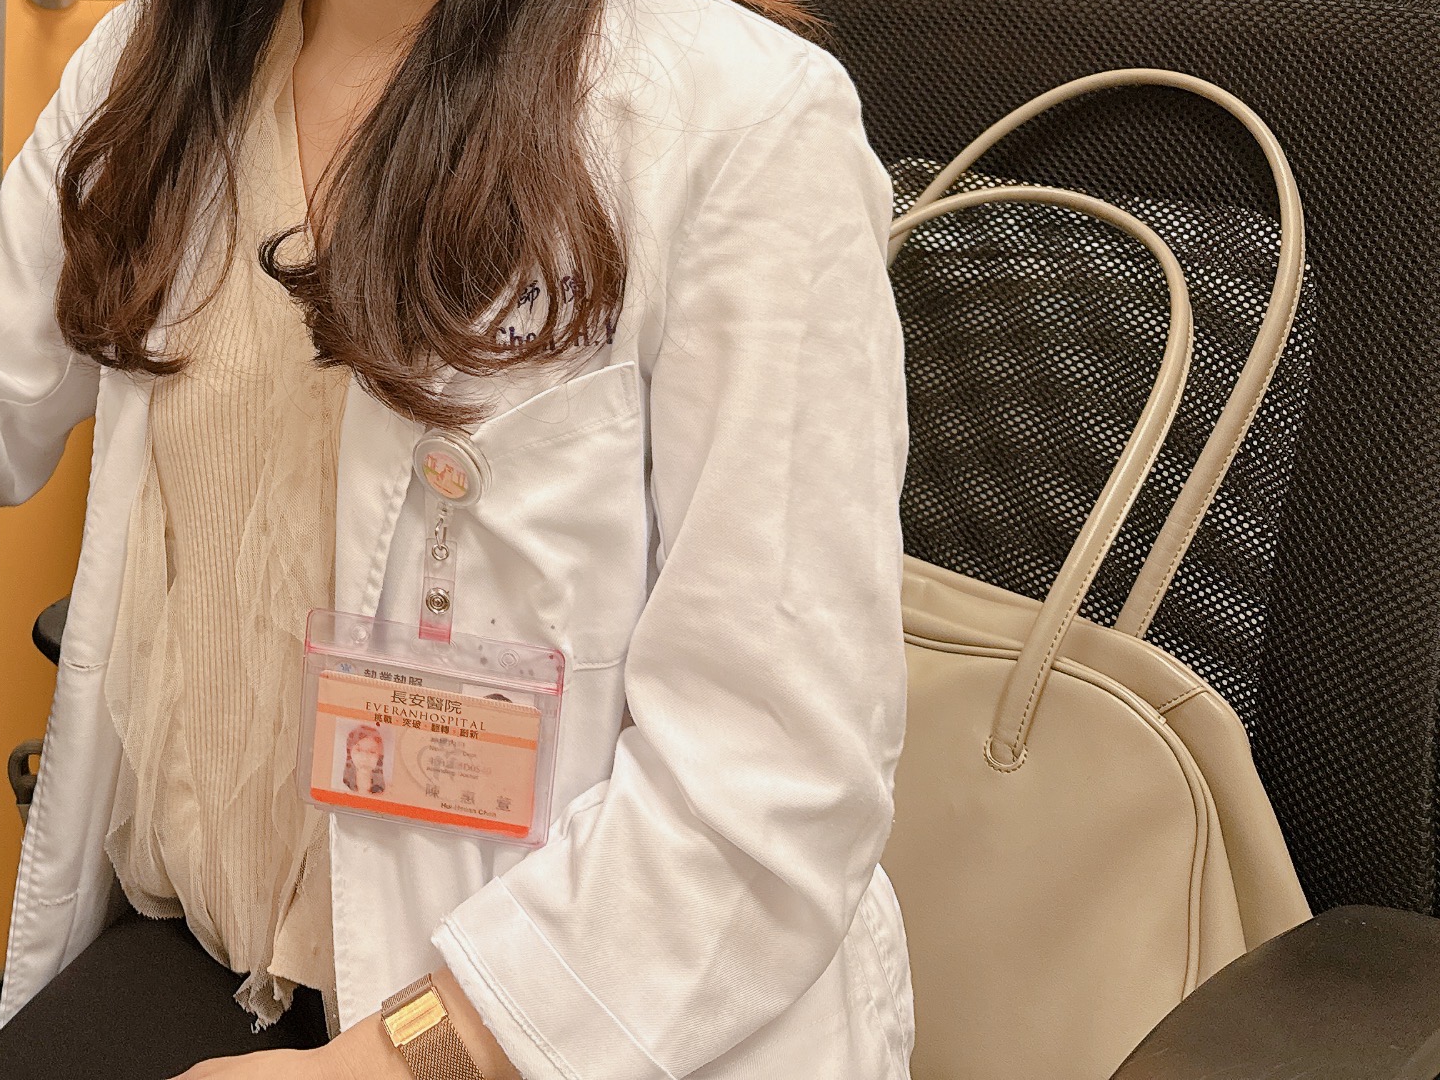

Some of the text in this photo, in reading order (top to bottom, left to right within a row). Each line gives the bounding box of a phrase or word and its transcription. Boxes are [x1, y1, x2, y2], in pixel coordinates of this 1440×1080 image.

[365, 700, 487, 732] EVERANHOSPITAL
[390, 689, 463, 715] 長安醫院
